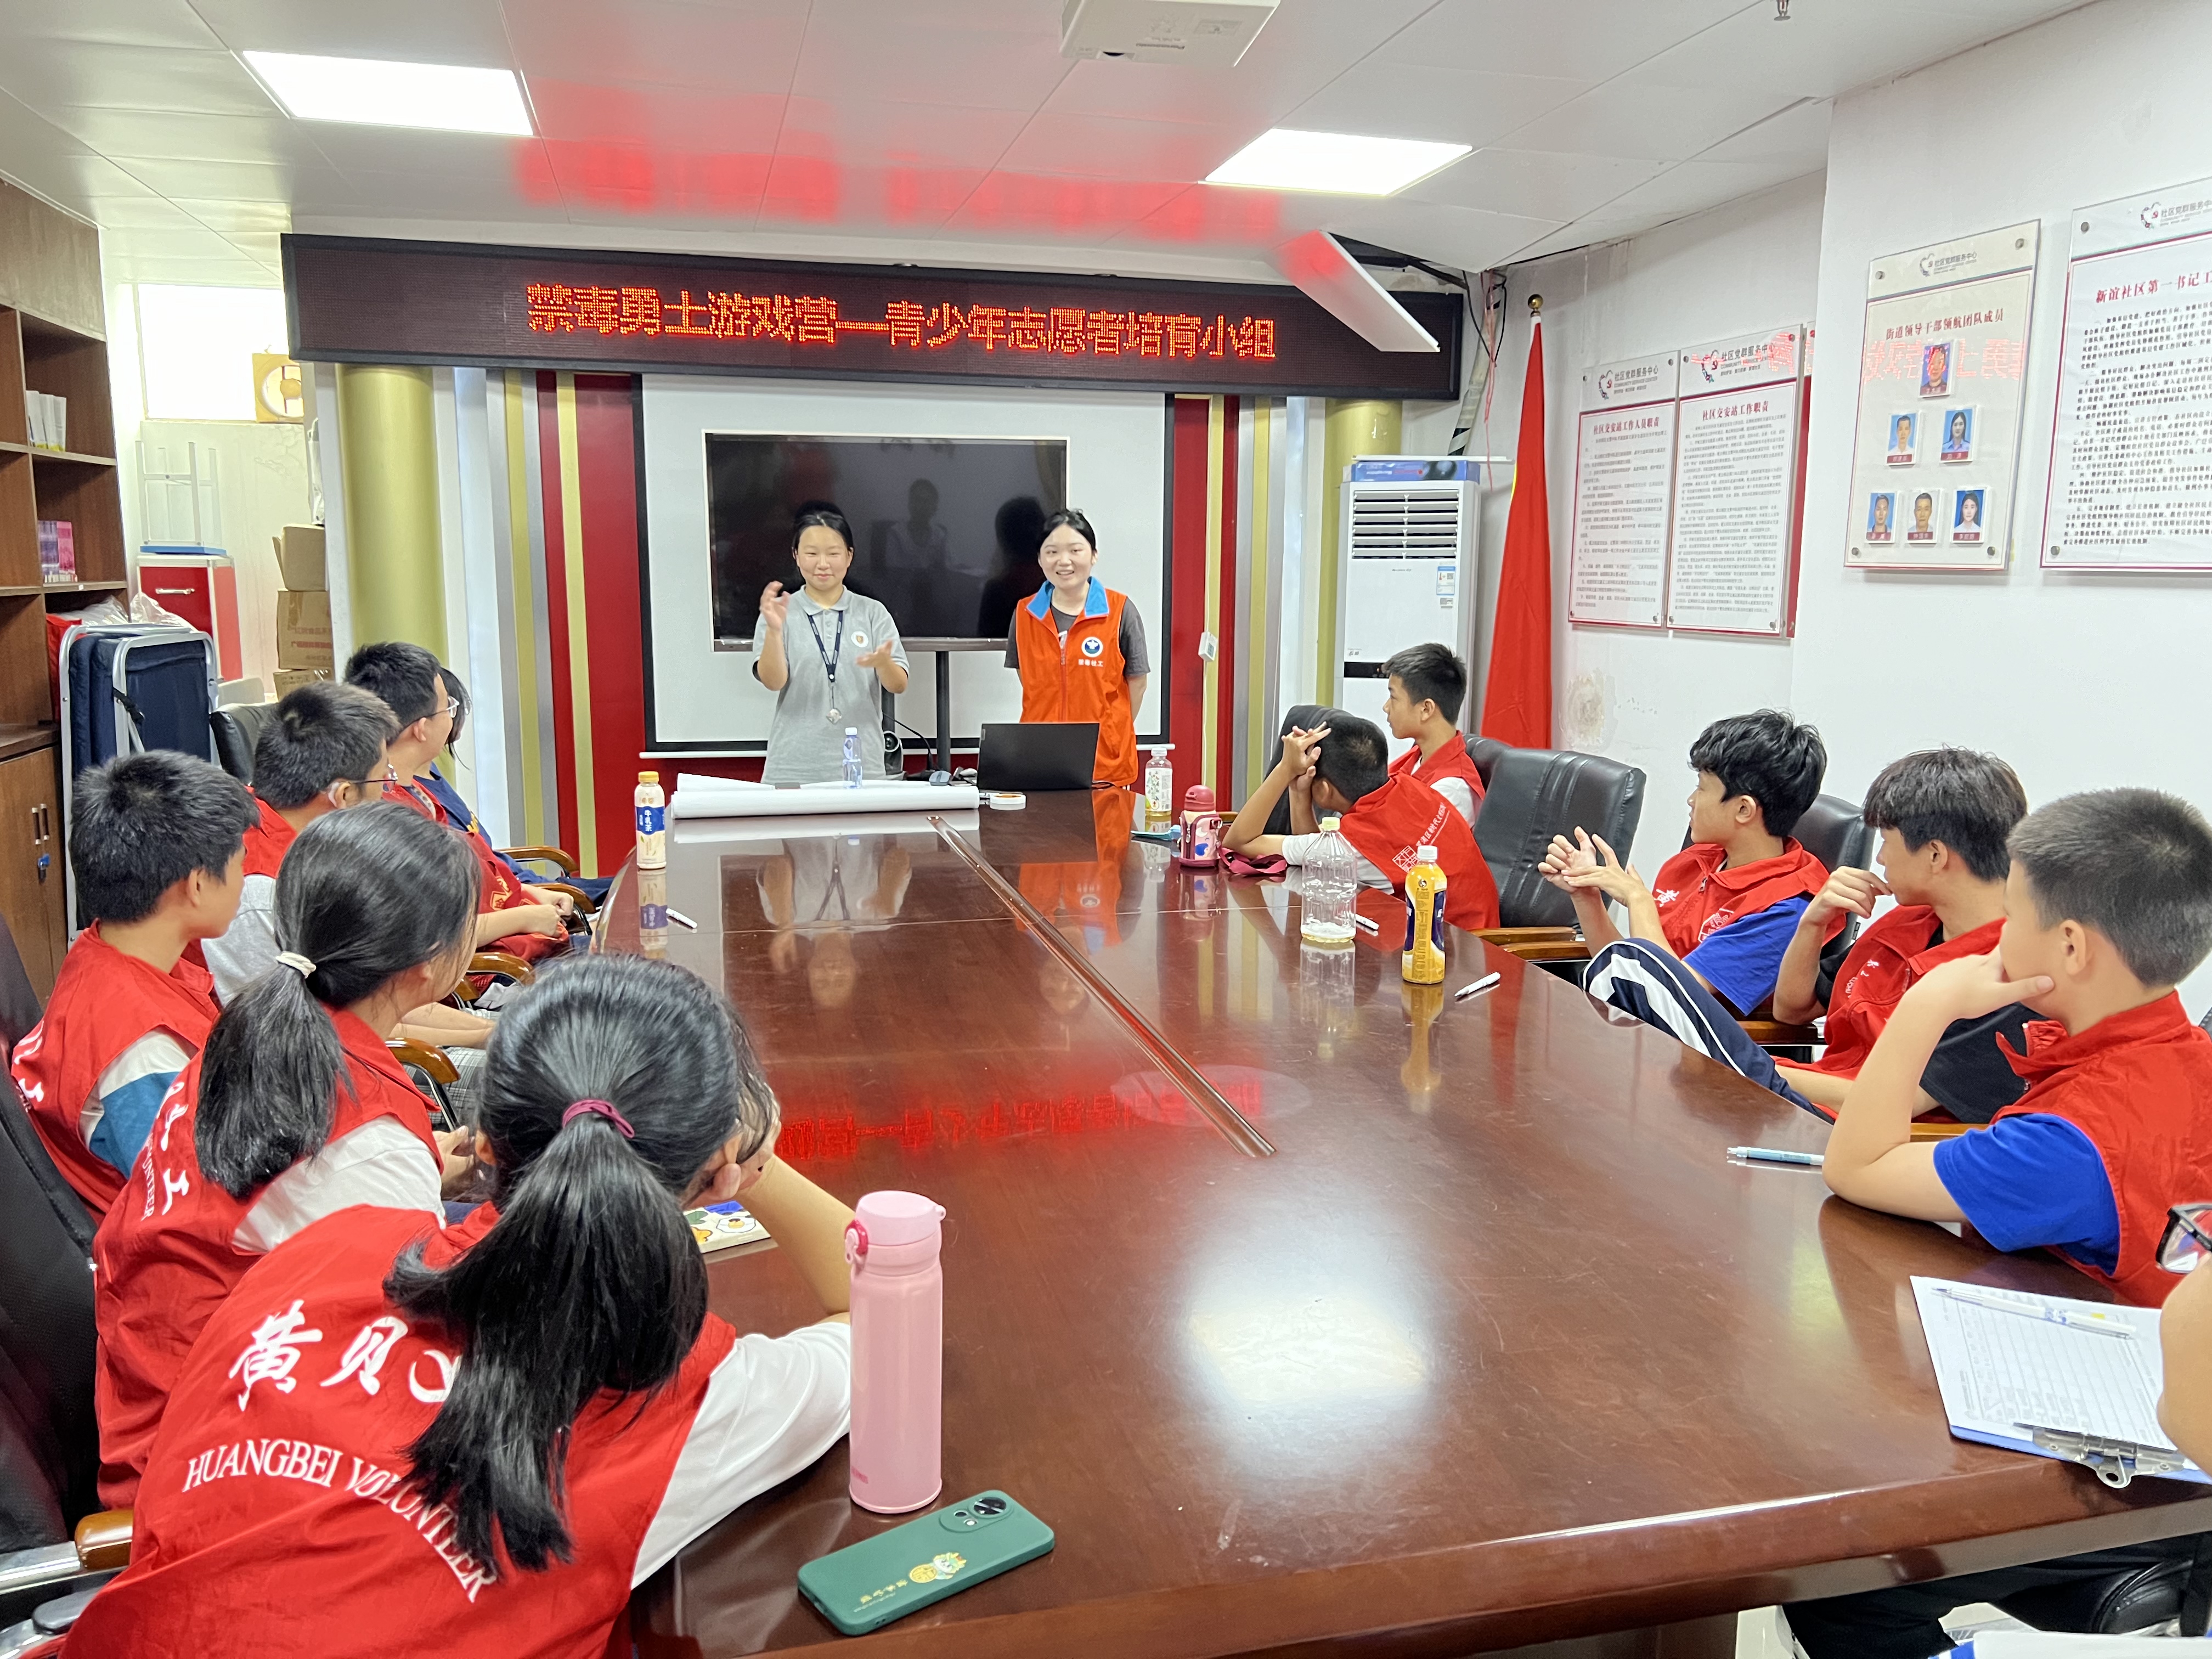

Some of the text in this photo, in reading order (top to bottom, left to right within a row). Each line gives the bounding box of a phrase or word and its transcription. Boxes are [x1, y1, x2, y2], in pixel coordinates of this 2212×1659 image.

[1886, 308, 2004, 340] 街道领导干部领航团队成员
[1702, 400, 1769, 421] 社区交安站工作职责
[1593, 417, 1660, 435] 社区交安站工作人员职责
[182, 1438, 343, 1493] HUANGBEI
